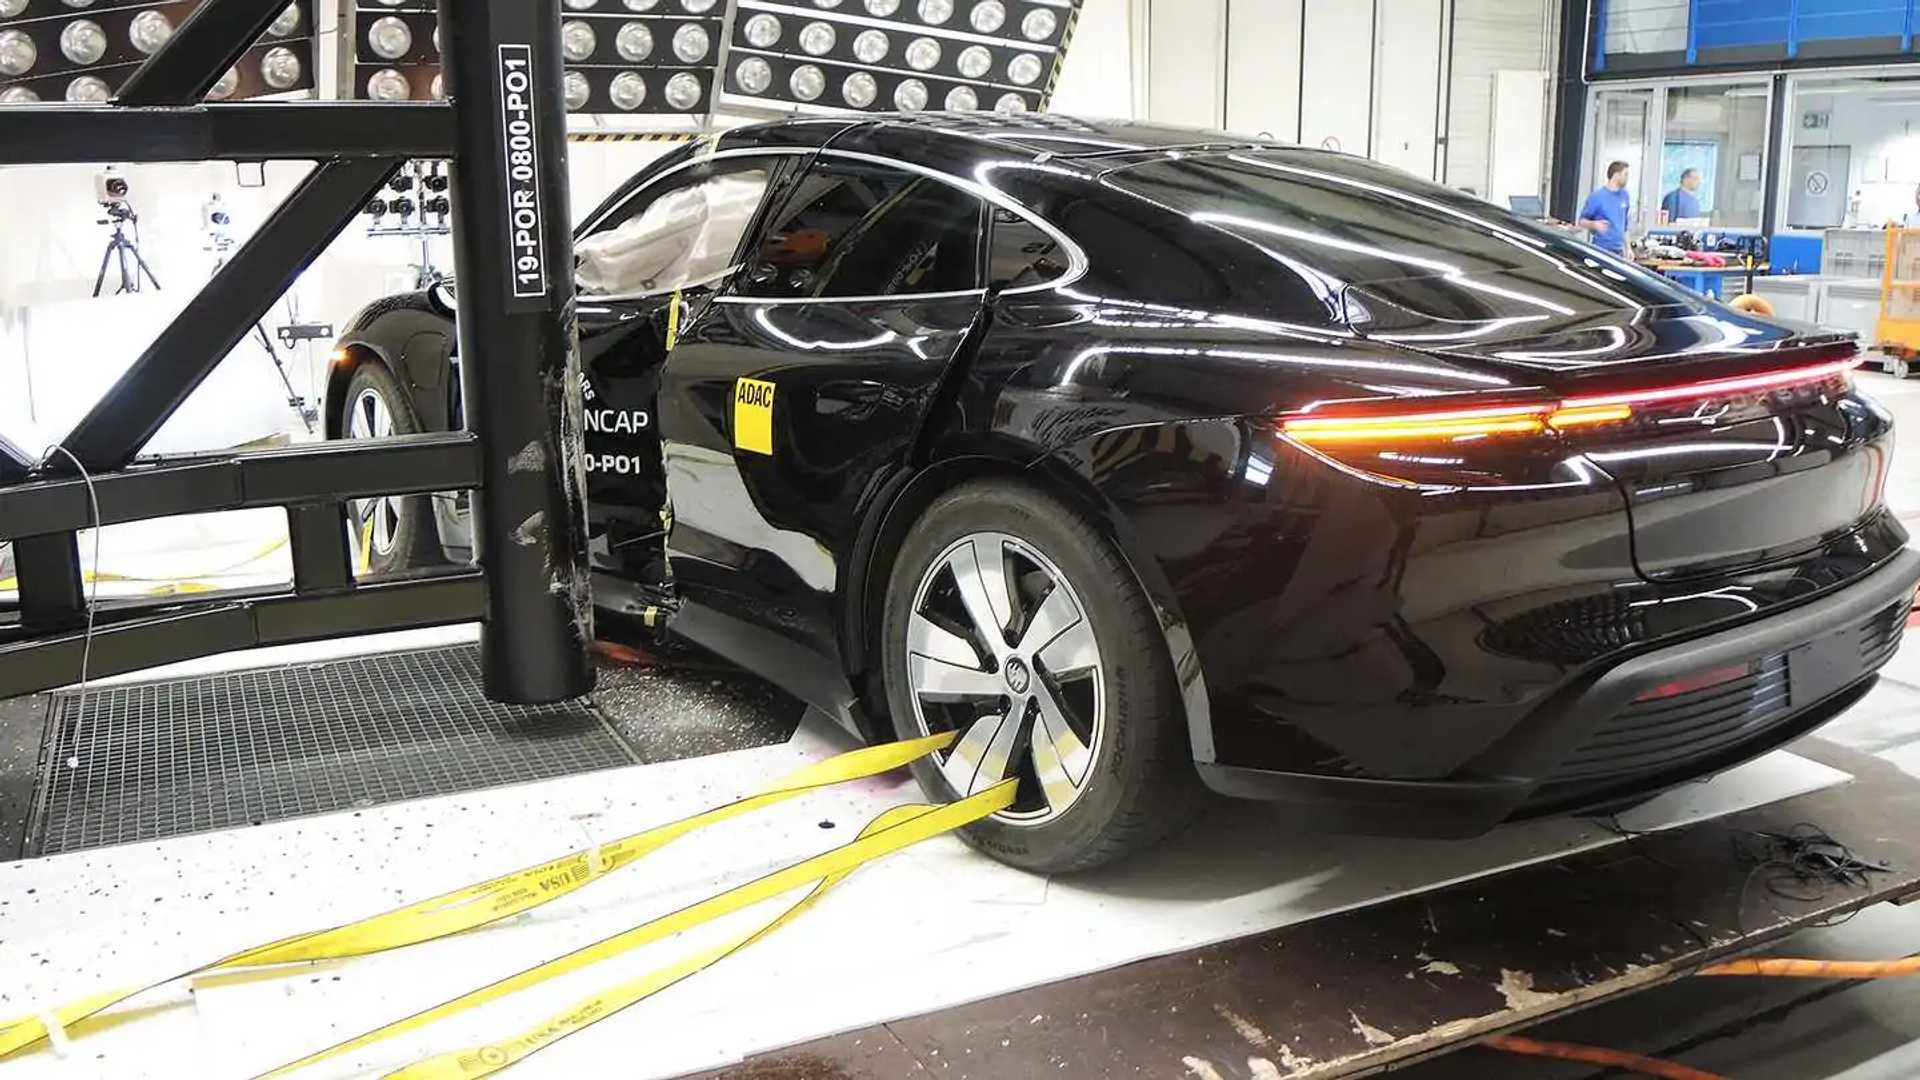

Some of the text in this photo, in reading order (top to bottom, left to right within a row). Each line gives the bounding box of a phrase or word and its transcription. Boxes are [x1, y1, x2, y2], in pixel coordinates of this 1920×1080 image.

[513, 189, 541, 285] 19-POR
[737, 382, 773, 408] ADAC
[584, 408, 649, 434] NCAP
